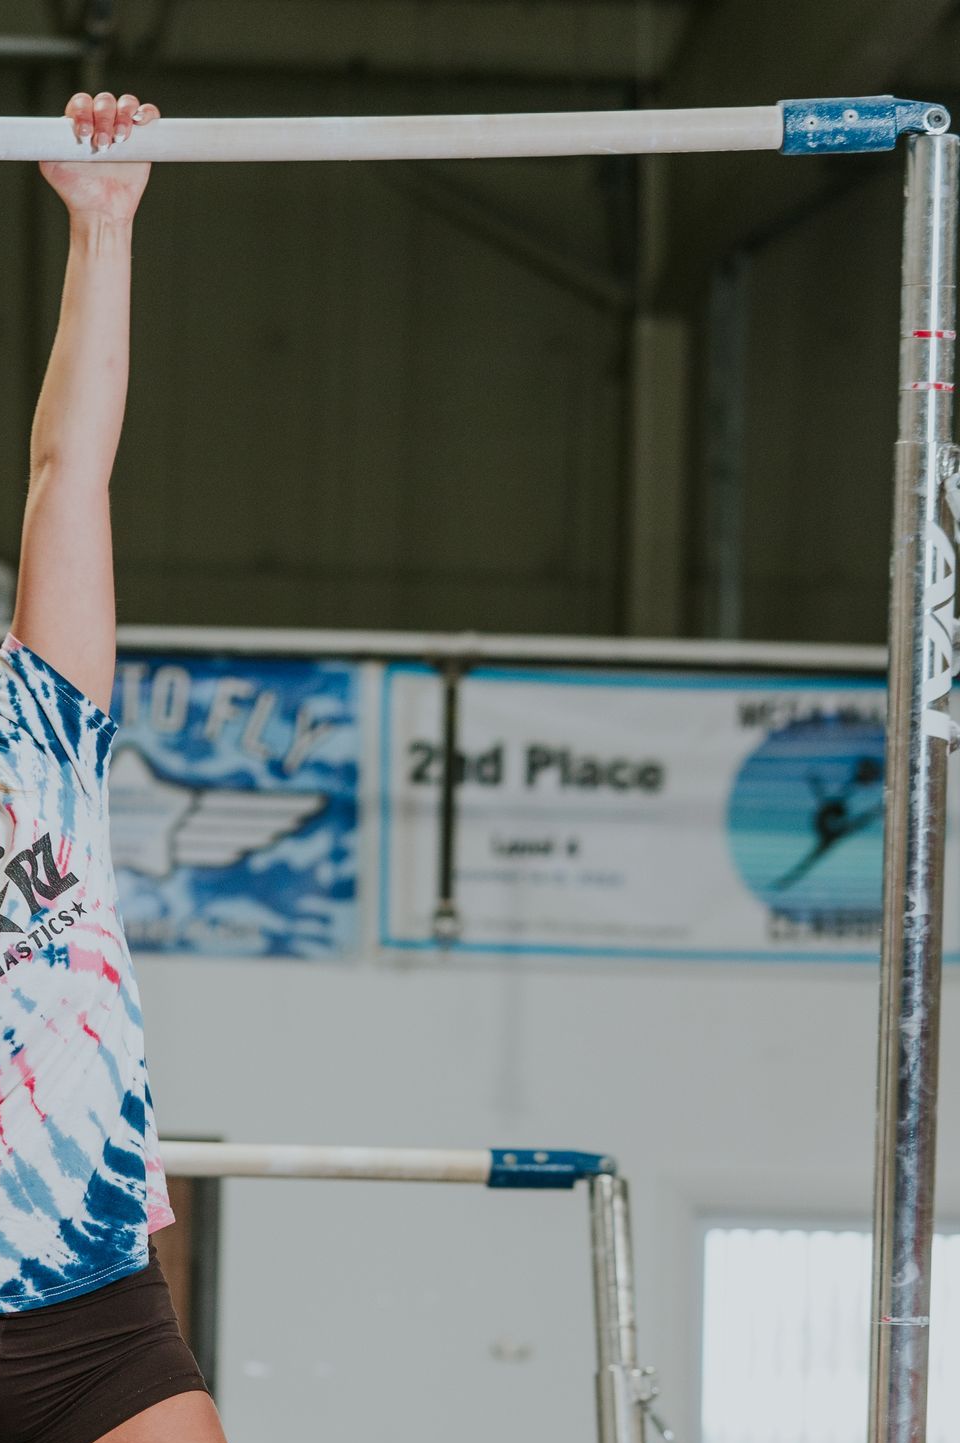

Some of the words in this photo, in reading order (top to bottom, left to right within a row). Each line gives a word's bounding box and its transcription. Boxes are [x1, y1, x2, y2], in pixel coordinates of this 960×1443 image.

[120, 661, 191, 733] TO
[205, 675, 337, 773] FLY
[524, 740, 665, 796] Place
